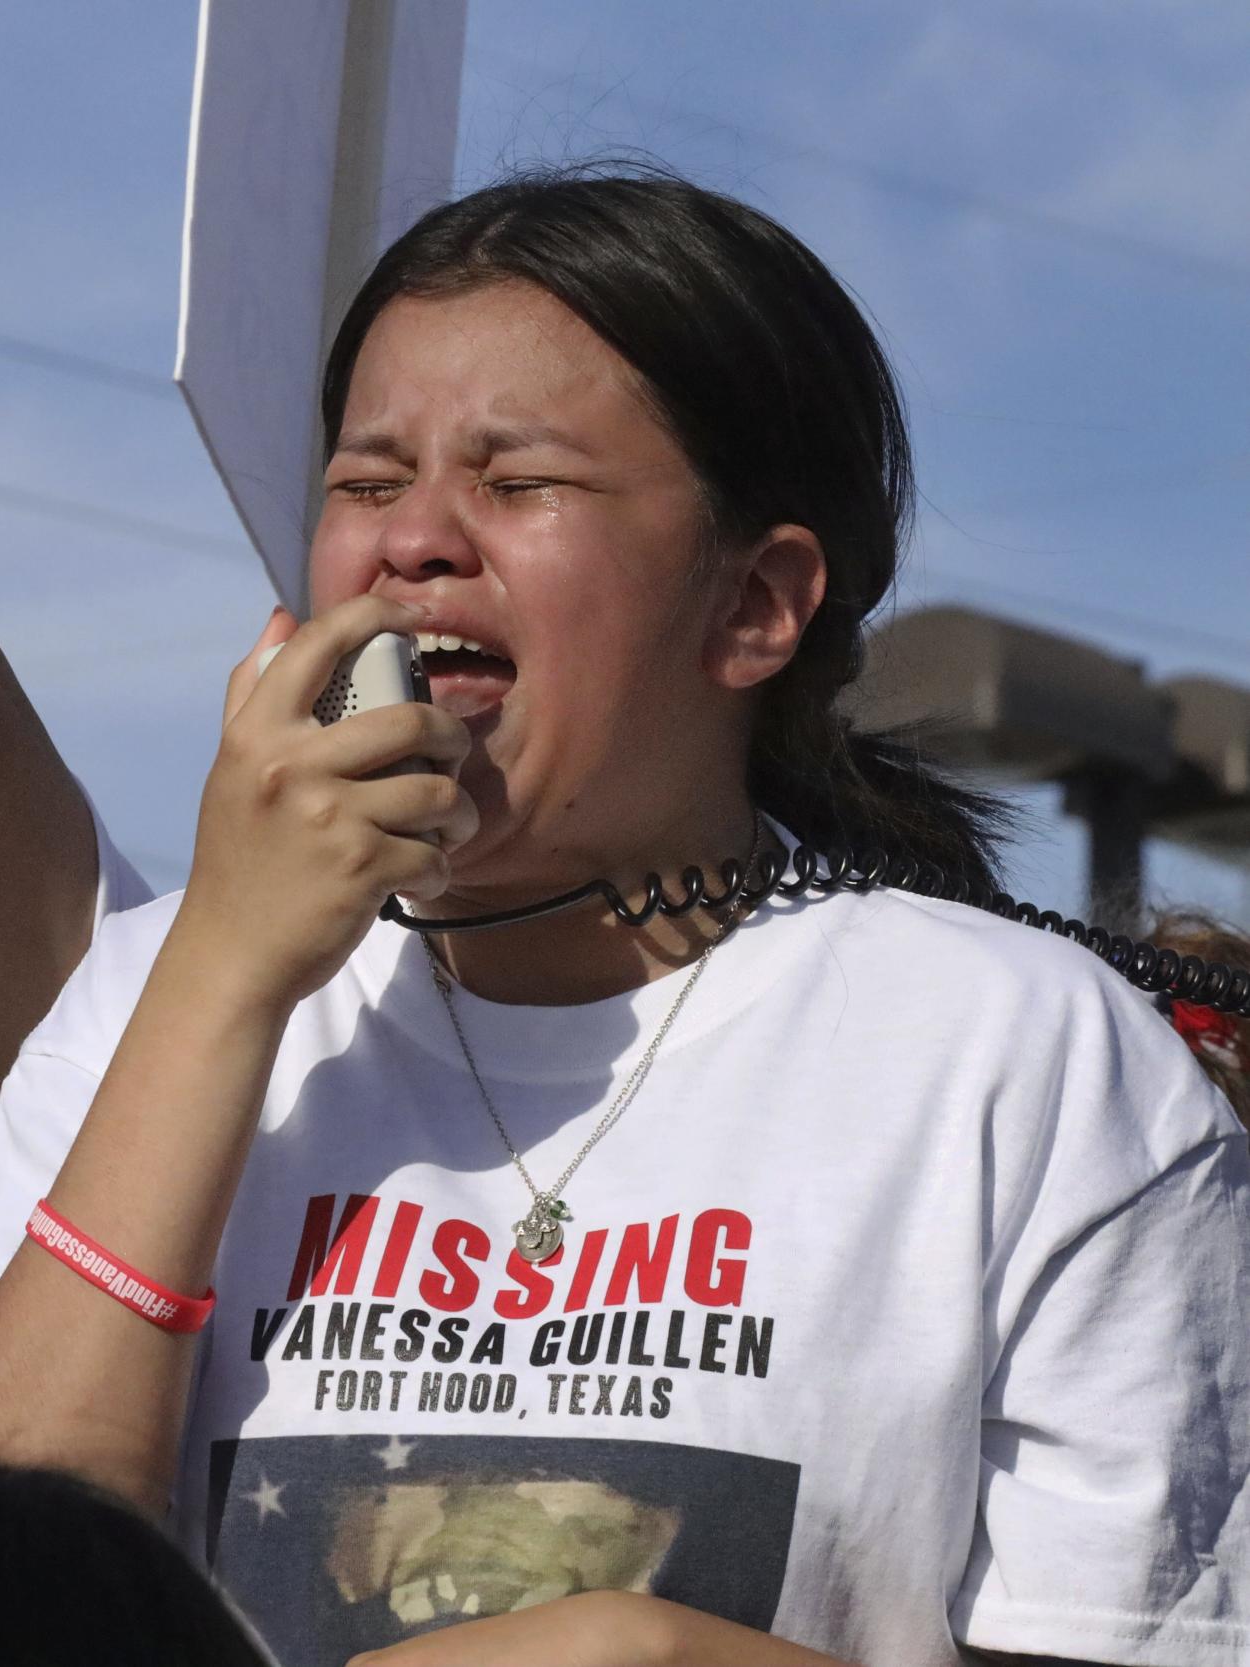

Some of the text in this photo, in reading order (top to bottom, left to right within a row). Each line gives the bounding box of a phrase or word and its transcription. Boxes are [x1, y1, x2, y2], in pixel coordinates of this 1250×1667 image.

[286, 1194, 752, 1320] MISSING
[250, 1303, 774, 1379] VANESSA GUILLEN
[314, 1370, 673, 1420] FORT HOOD, TEXAS
